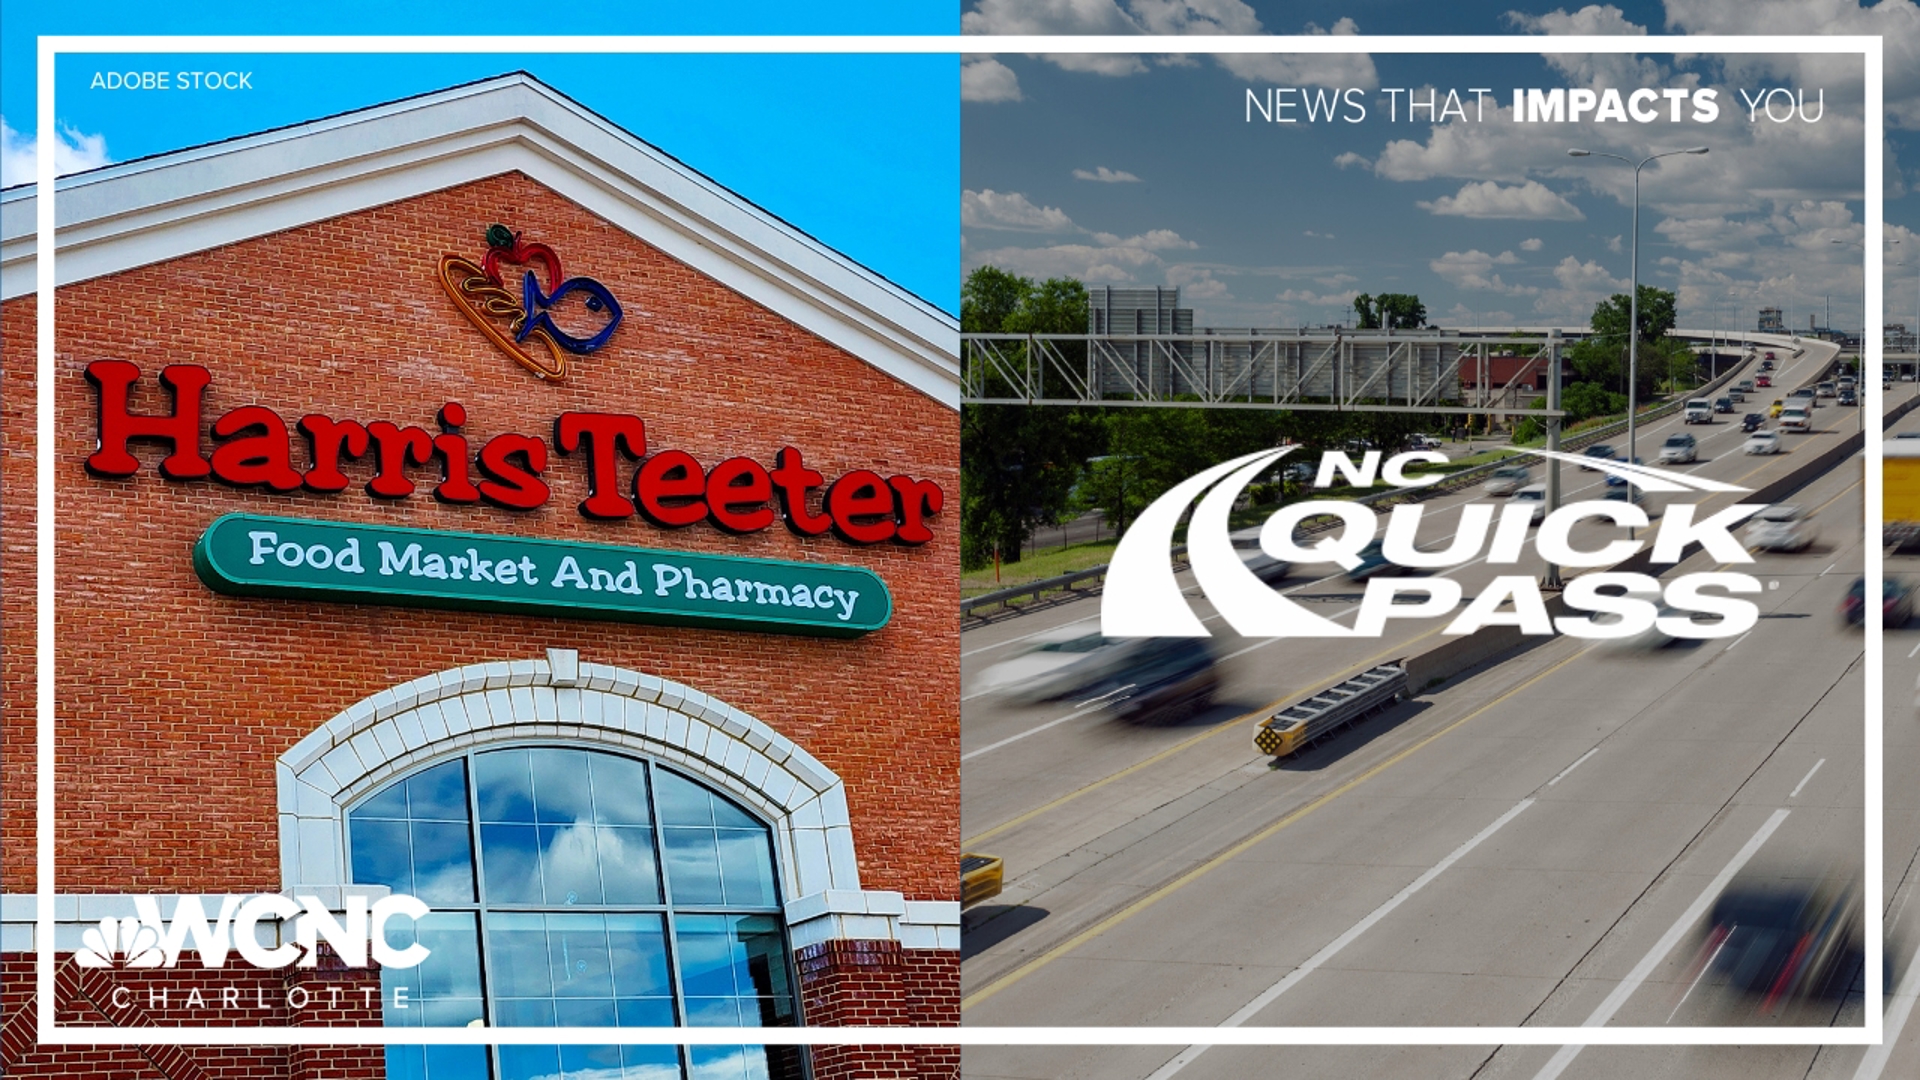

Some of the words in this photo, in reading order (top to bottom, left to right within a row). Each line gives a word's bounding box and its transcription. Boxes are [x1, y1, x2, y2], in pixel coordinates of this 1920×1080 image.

[84, 359, 551, 511] Harris
[553, 411, 945, 546] Teeter
[248, 531, 364, 574] Food
[379, 543, 538, 587] Market
[551, 556, 643, 596] And
[654, 563, 859, 621] Pharmacy
